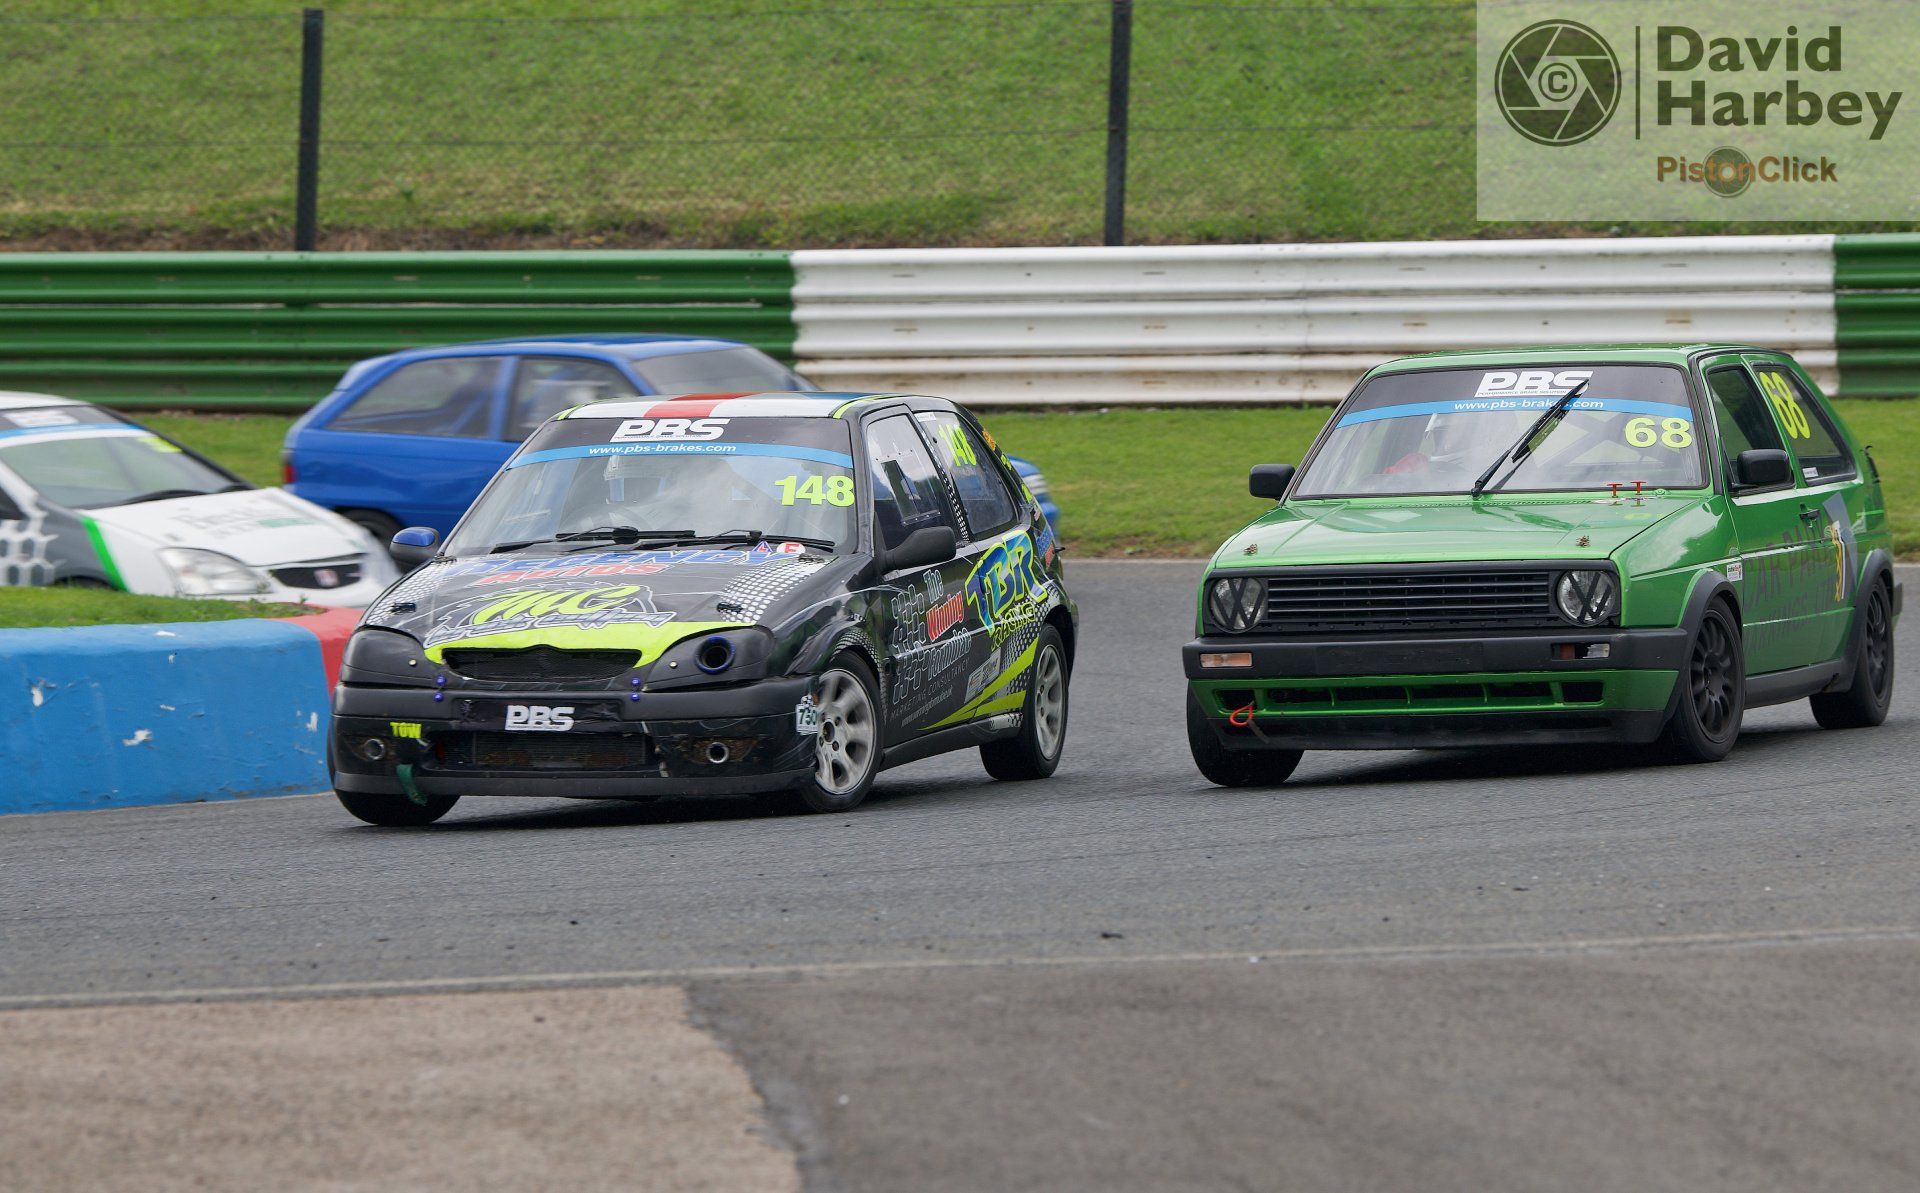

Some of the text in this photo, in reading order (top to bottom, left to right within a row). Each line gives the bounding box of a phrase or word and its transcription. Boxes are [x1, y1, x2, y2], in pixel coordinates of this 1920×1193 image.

[1474, 371, 1593, 397] PBS
[1760, 371, 1811, 439] 68
[609, 418, 731, 443] PBS
[1625, 417, 1693, 448] 68
[588, 444, 737, 454] www.pbs-brakes.com
[774, 475, 855, 507] 148
[923, 569, 944, 604] The
[965, 529, 1048, 636] TBR
[926, 591, 964, 642] Winning
[390, 721, 422, 738] TOW
[505, 705, 575, 731] PBS
